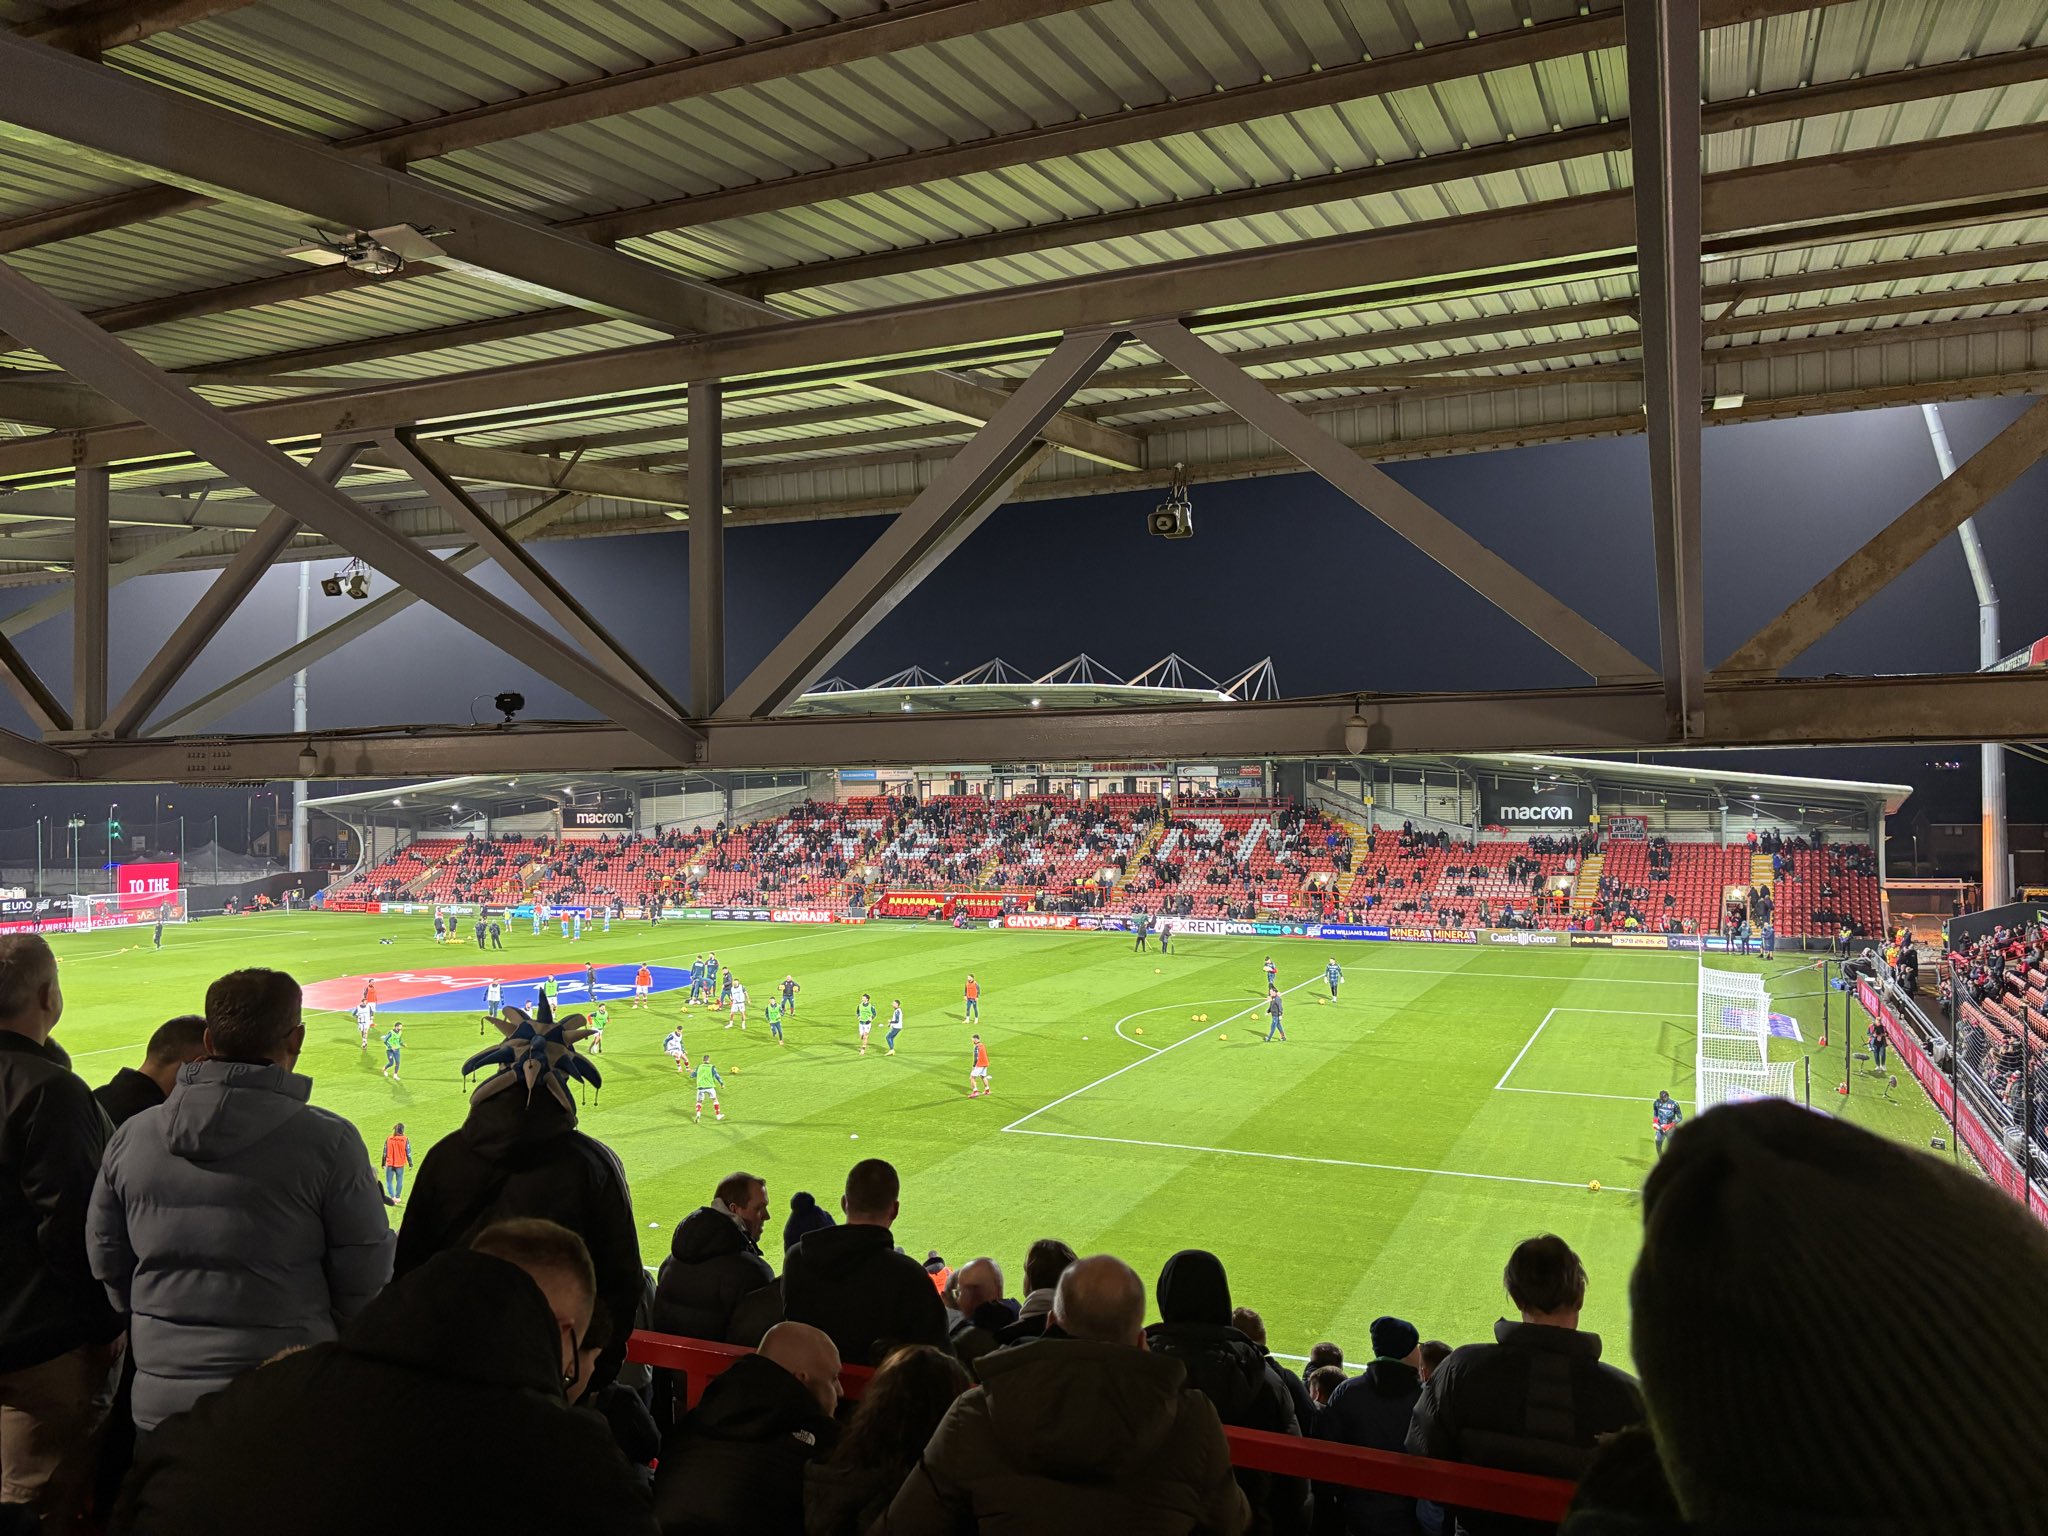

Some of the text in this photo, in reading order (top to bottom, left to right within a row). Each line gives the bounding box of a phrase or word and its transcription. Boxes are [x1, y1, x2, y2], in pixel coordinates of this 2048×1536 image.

[576, 812, 624, 824] macron
[1500, 806, 1573, 820] macron
[128, 877, 170, 893] TO THE
[773, 910, 830, 922] GATORADE
[1007, 916, 1072, 927] GATORADE
[1226, 923, 1252, 934] orca
[1433, 929, 1470, 939] MINERA
[1490, 933, 1557, 943] Castle Green
